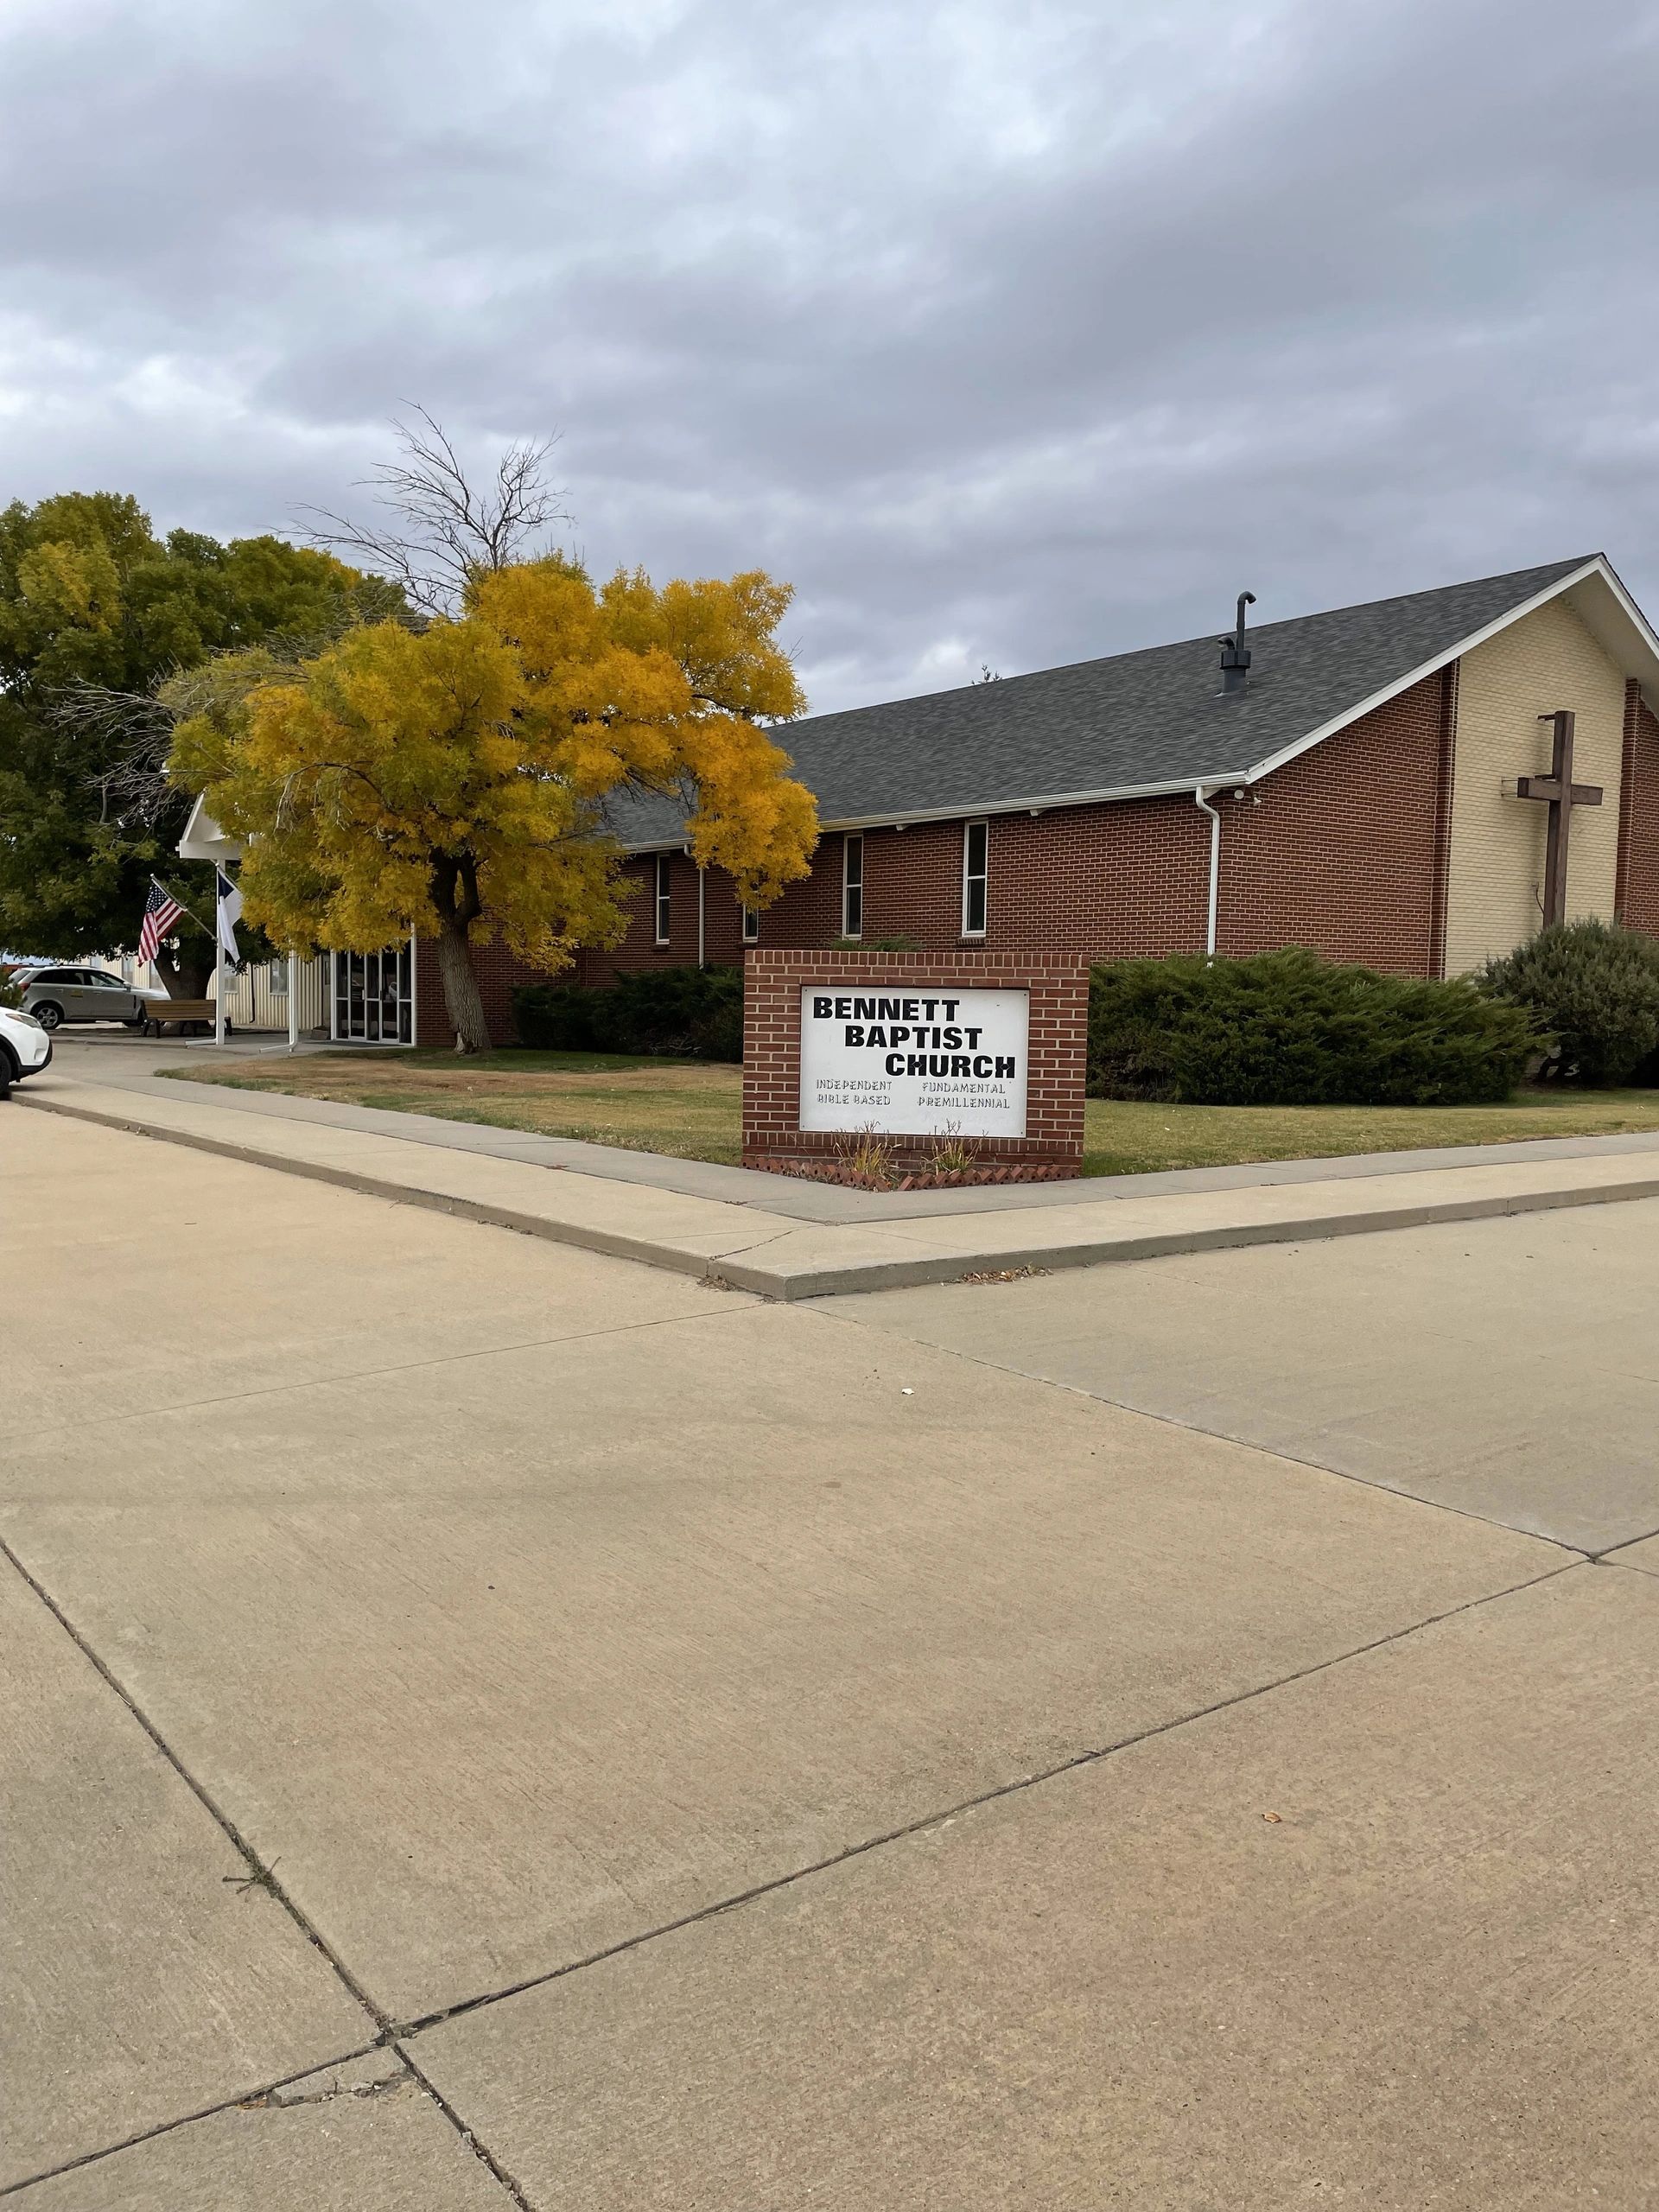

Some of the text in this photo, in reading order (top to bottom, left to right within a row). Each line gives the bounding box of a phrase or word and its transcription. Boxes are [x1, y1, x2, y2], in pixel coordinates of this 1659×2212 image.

[813, 996, 960, 1021] BENNETT
[845, 1025, 982, 1050] BAPTIST
[886, 1053, 1015, 1078] CHURCH
[816, 1079, 893, 1090] INDEPENDENT
[921, 1083, 1006, 1094] FUNDAMENTAL
[817, 1094, 891, 1106] BIBLE BASED
[918, 1096, 1010, 1109] PREMILLENNIAL
